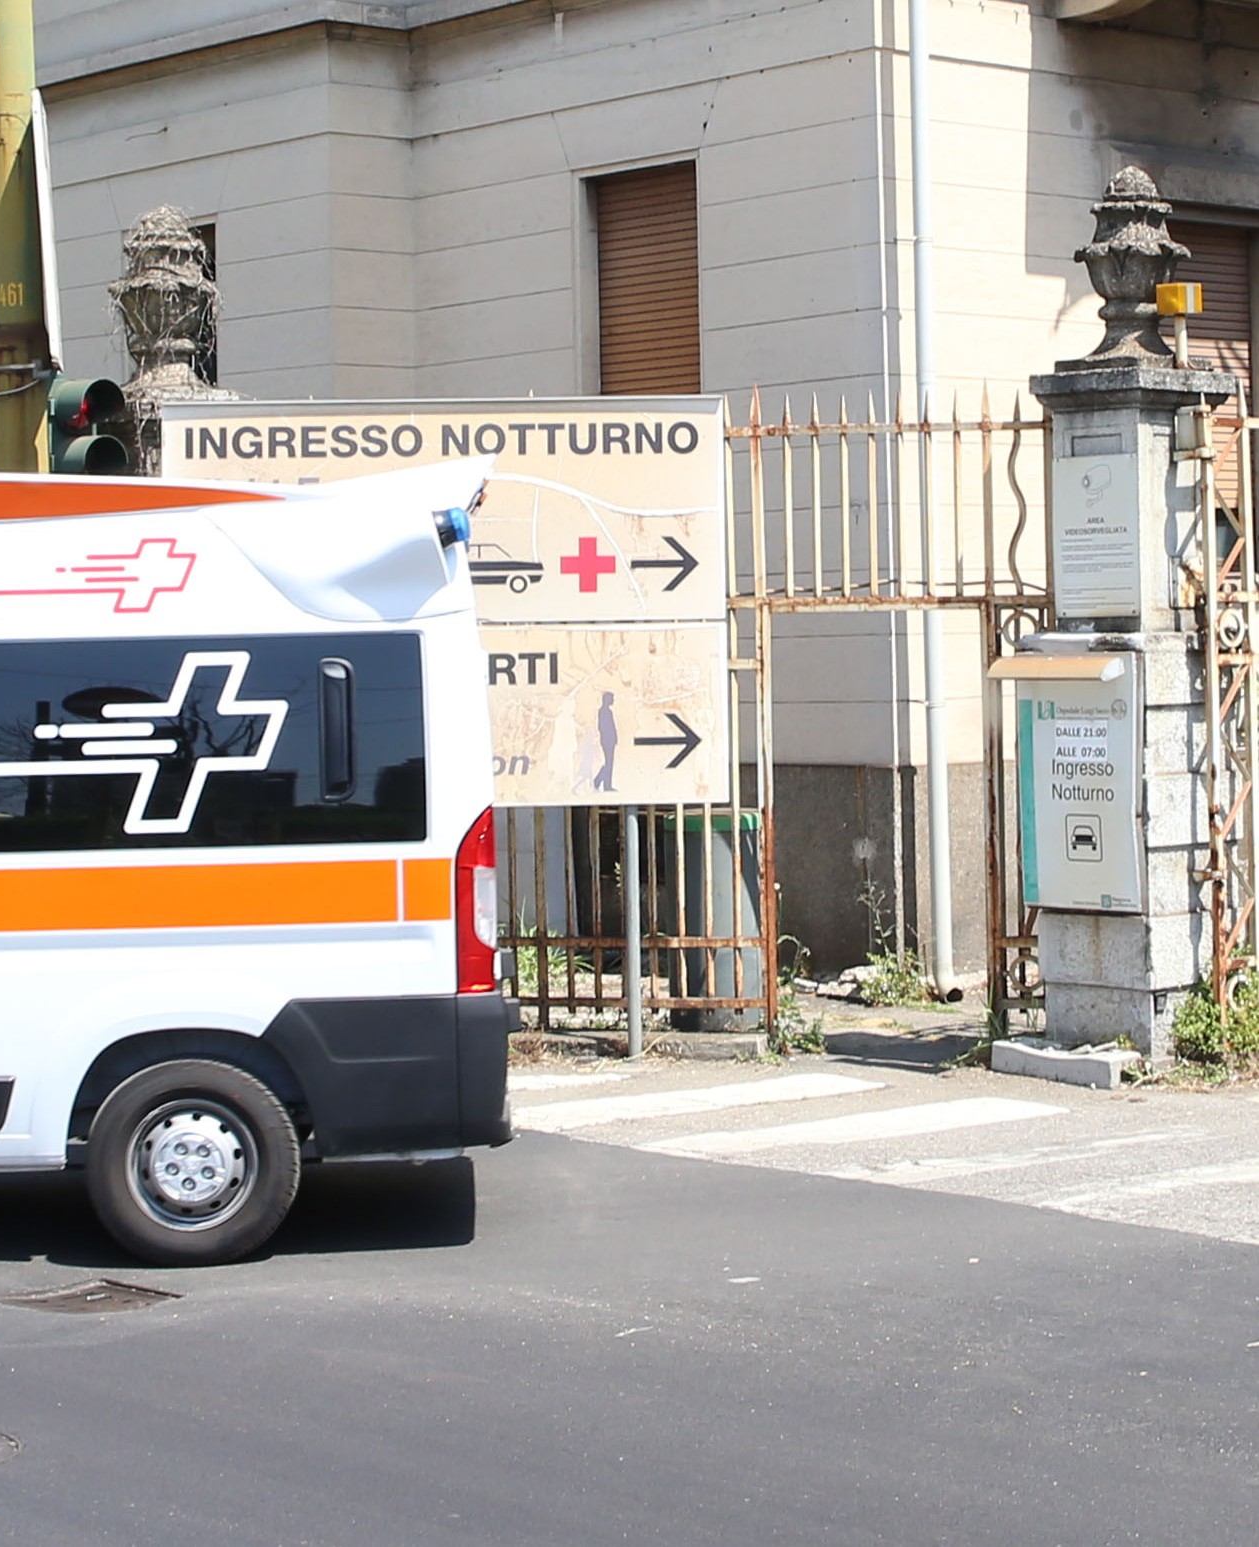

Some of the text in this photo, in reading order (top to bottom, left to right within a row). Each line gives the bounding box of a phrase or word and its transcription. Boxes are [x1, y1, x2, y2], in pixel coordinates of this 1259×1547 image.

[184, 421, 700, 460] INGRESSO NOTTURNO
[487, 652, 558, 685] RTI
[1056, 727, 1107, 737] DALLE 21:00
[1056, 746, 1106, 758] ALLE 07:00
[1052, 759, 1114, 780] Ingresso
[1052, 783, 1115, 802] Notturno
